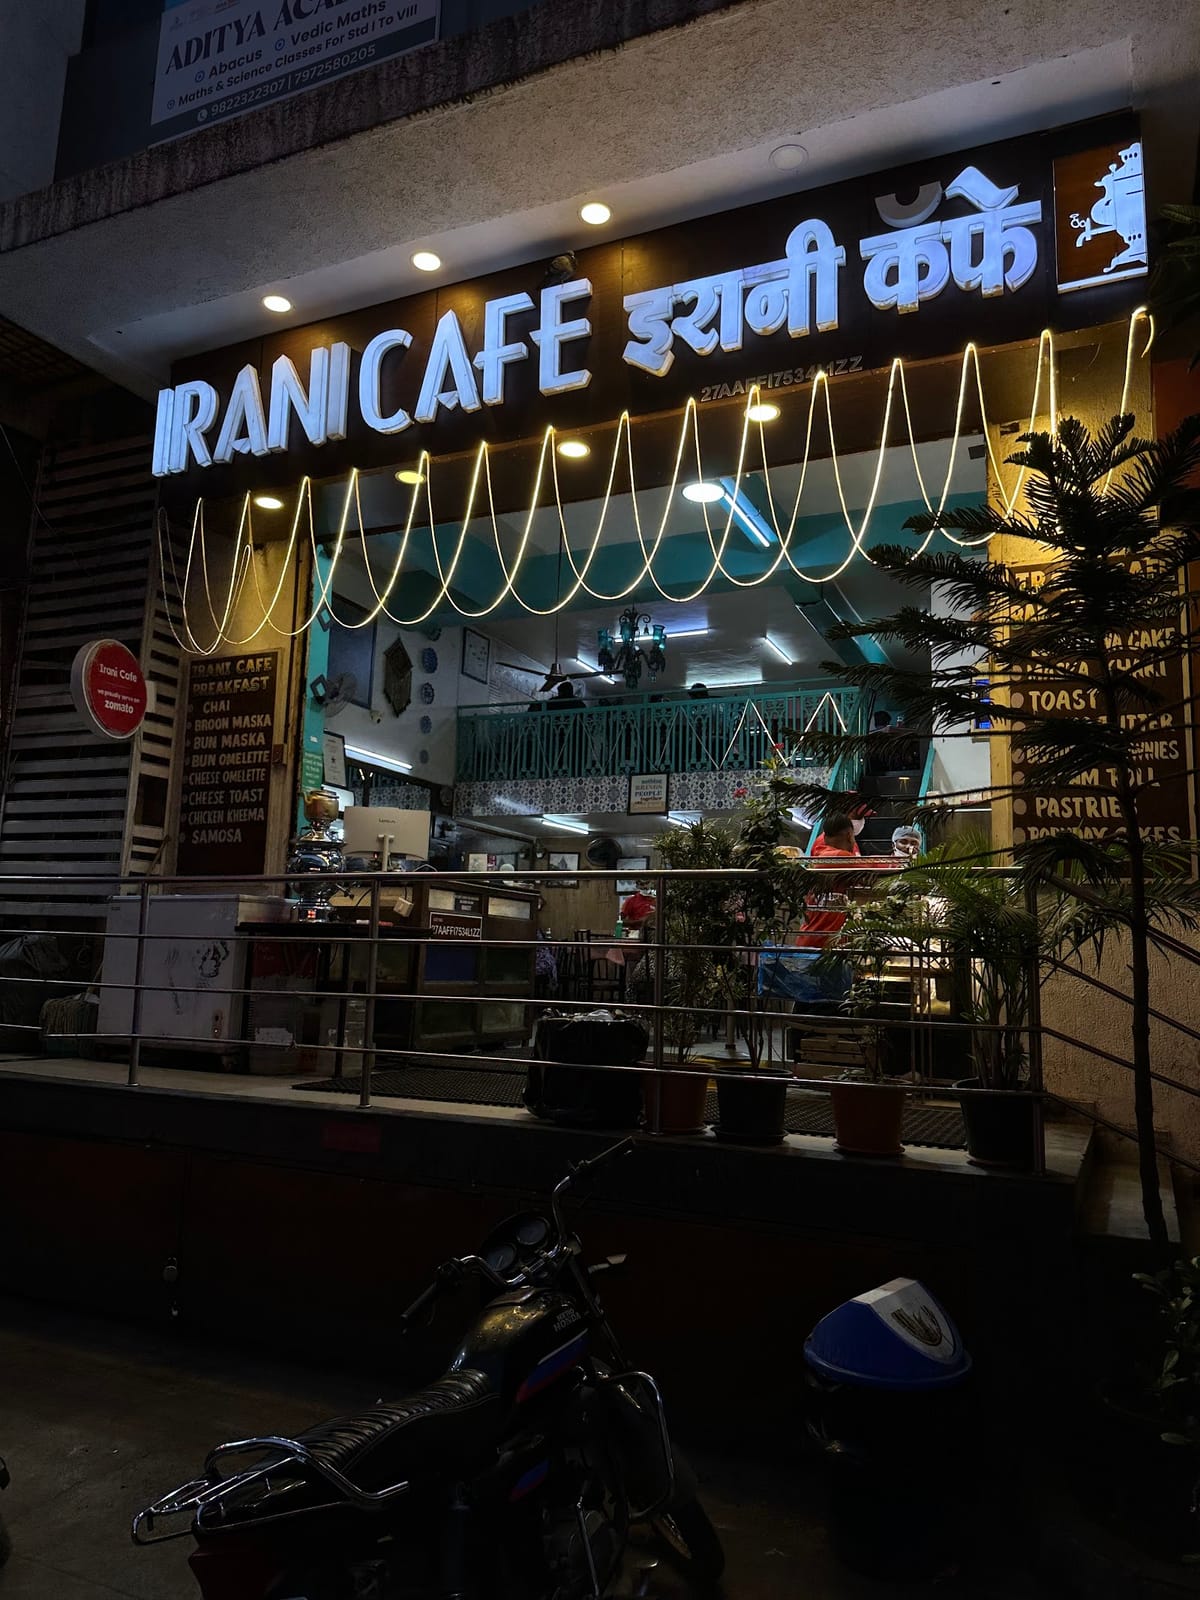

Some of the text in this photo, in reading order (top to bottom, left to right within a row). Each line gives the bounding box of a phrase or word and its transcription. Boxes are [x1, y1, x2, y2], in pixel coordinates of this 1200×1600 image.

[164, 11, 265, 75] ADITYA
[208, 0, 387, 78] Abacus Vedic Maths
[178, 82, 213, 107] Maths
[215, 79, 224, 91] &
[226, 62, 272, 87] Science
[274, 44, 322, 70] Classes
[325, 33, 346, 50] For
[348, 23, 369, 41] Std
[378, 16, 394, 29] To
[397, 4, 418, 22] VIII
[211, 79, 285, 116] 9822322307
[295, 44, 377, 84] 7972580205
[622, 218, 846, 377] इरानी
[152, 277, 593, 477] IRANI CAFE
[99, 663, 137, 682] Irani Cafe
[235, 657, 272, 674] CAFE
[192, 675, 270, 695] BREAKFAST
[104, 700, 134, 714] zomato
[203, 699, 231, 714] CHAI
[1028, 688, 1098, 712] TOAST
[194, 714, 272, 733] BROON MASKA
[193, 732, 267, 750] BUN MASKA
[191, 750, 270, 768] BUN OMELETTE
[188, 768, 267, 786] CHEESE OMELETTE
[188, 788, 265, 807] CHEESE TOAST
[1036, 796, 1138, 818] PASTRIE
[188, 807, 266, 826] CHICKEN KHEEMA
[191, 828, 243, 845] SAMOSA
